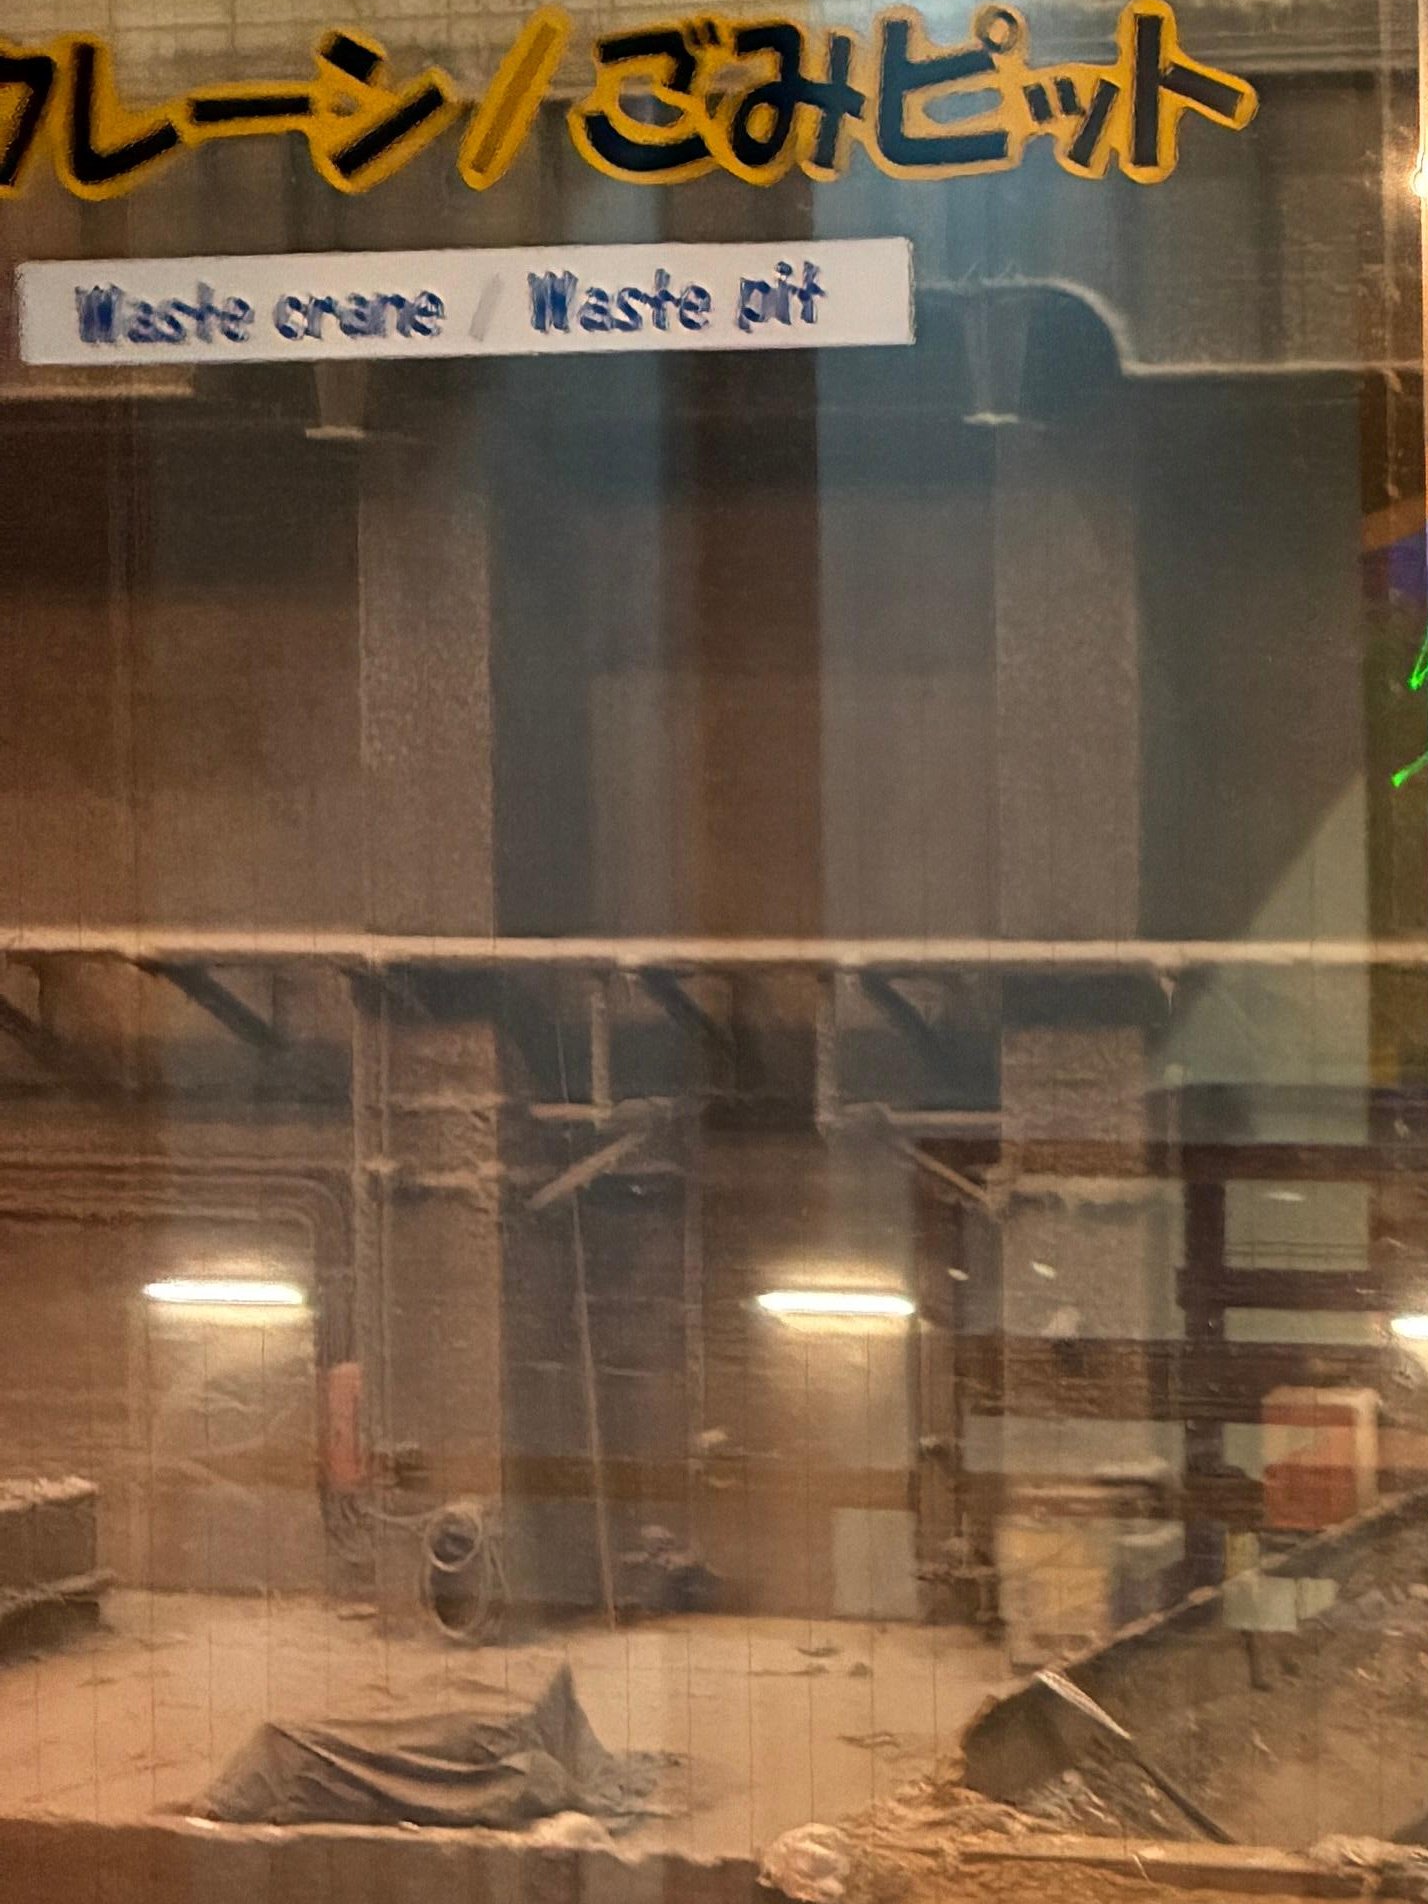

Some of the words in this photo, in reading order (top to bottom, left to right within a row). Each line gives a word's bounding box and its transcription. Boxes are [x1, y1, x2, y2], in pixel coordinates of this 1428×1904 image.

[76, 282, 255, 345] Waste
[273, 290, 445, 340] crane
[527, 269, 712, 333] Waste
[738, 260, 826, 333] pit
